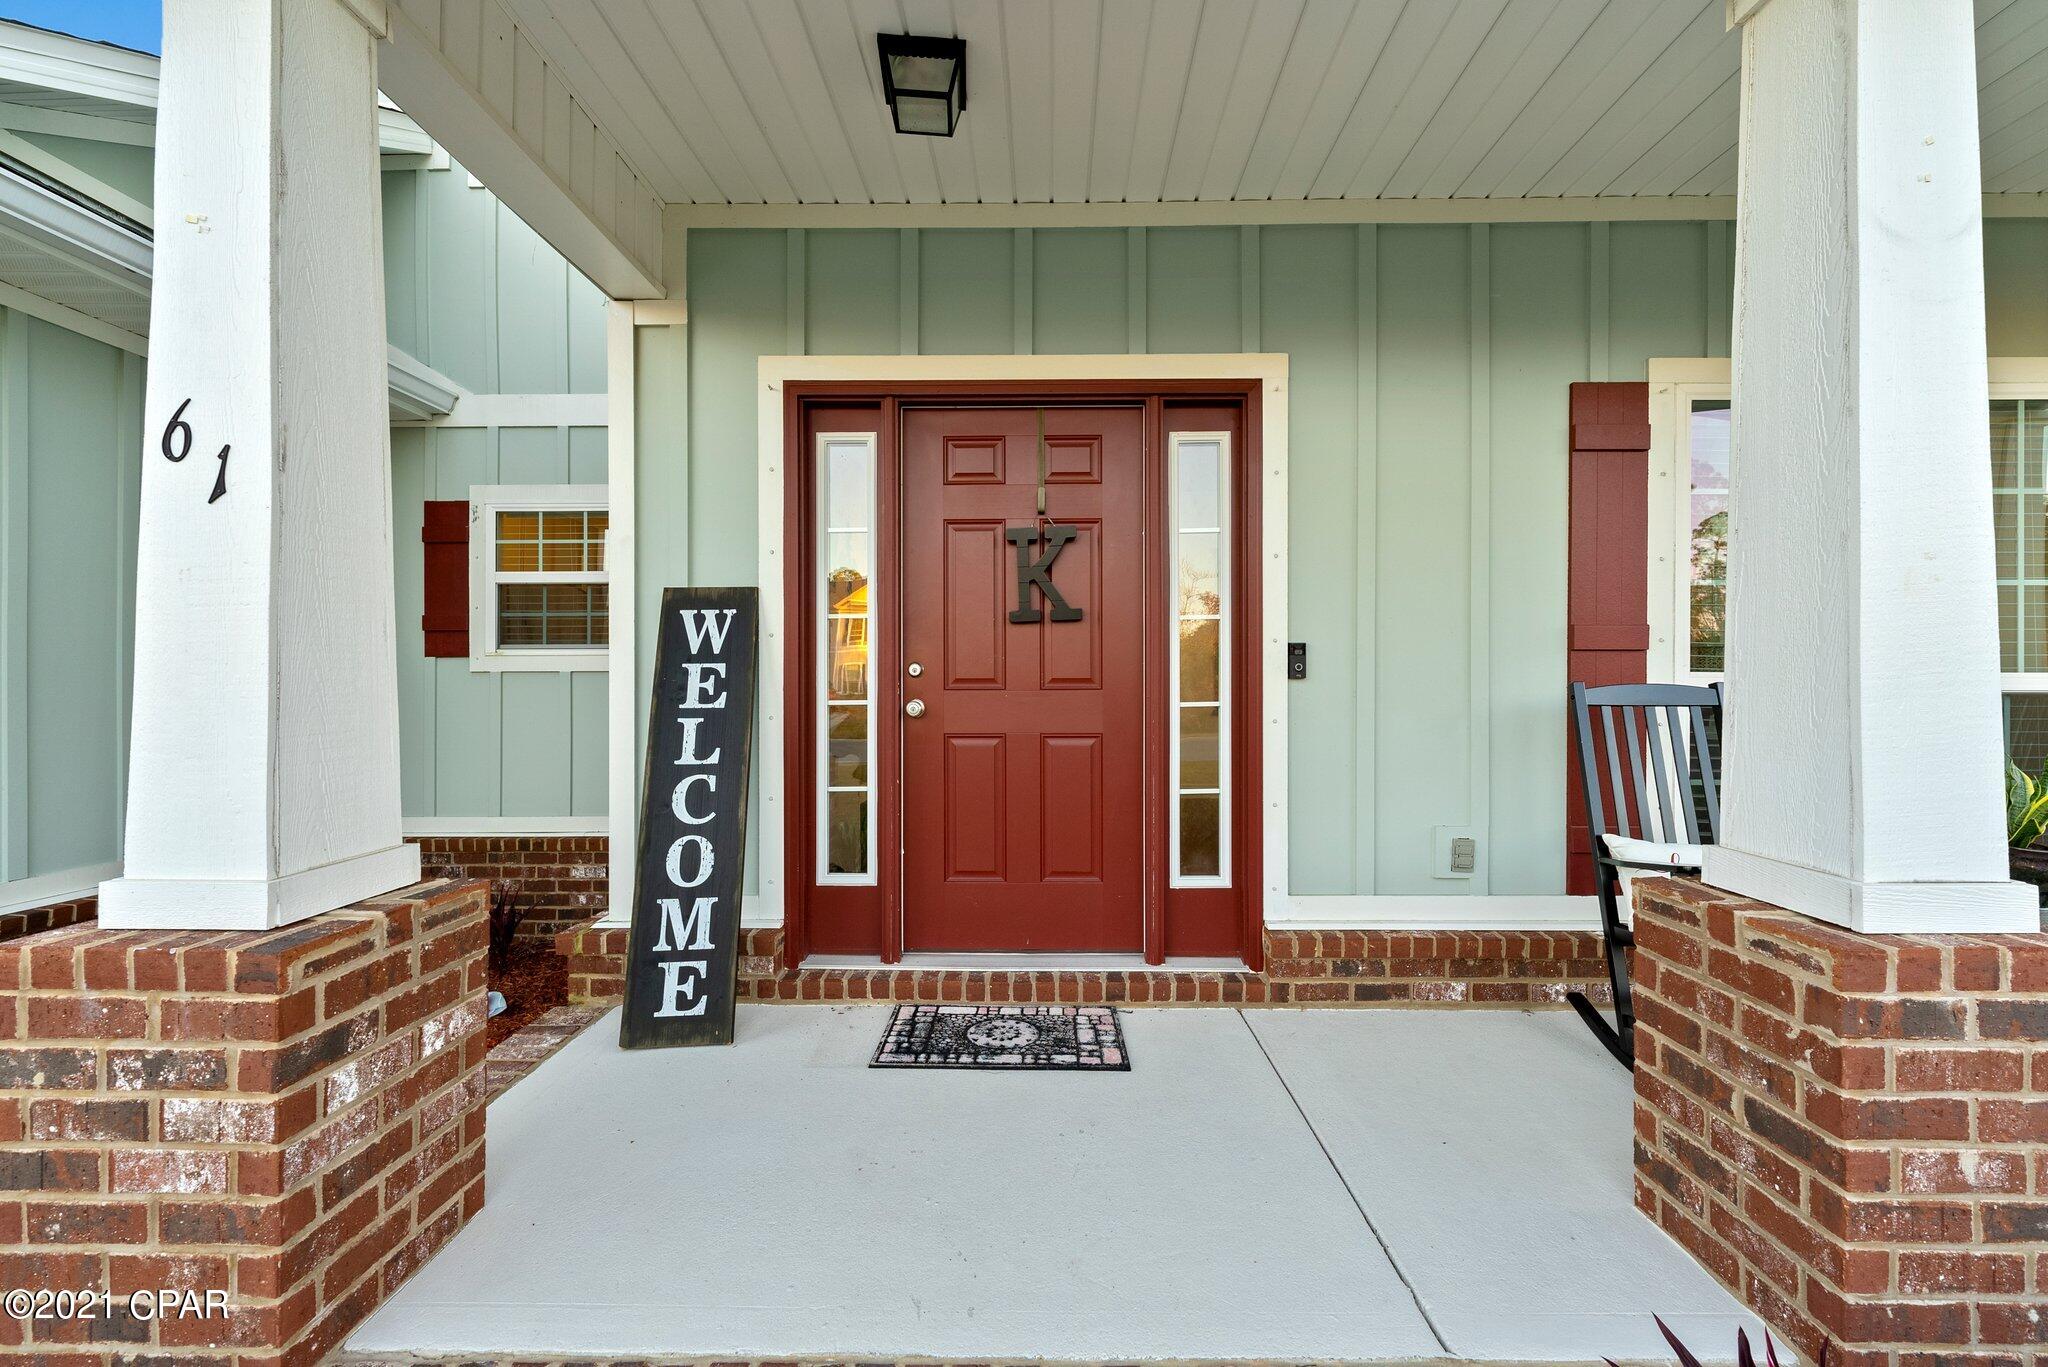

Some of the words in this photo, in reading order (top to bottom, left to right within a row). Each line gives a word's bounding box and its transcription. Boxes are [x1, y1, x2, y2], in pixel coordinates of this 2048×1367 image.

[161, 398, 231, 504] 61
[1006, 525, 1083, 625] K
[653, 609, 737, 1018] WELCOME
